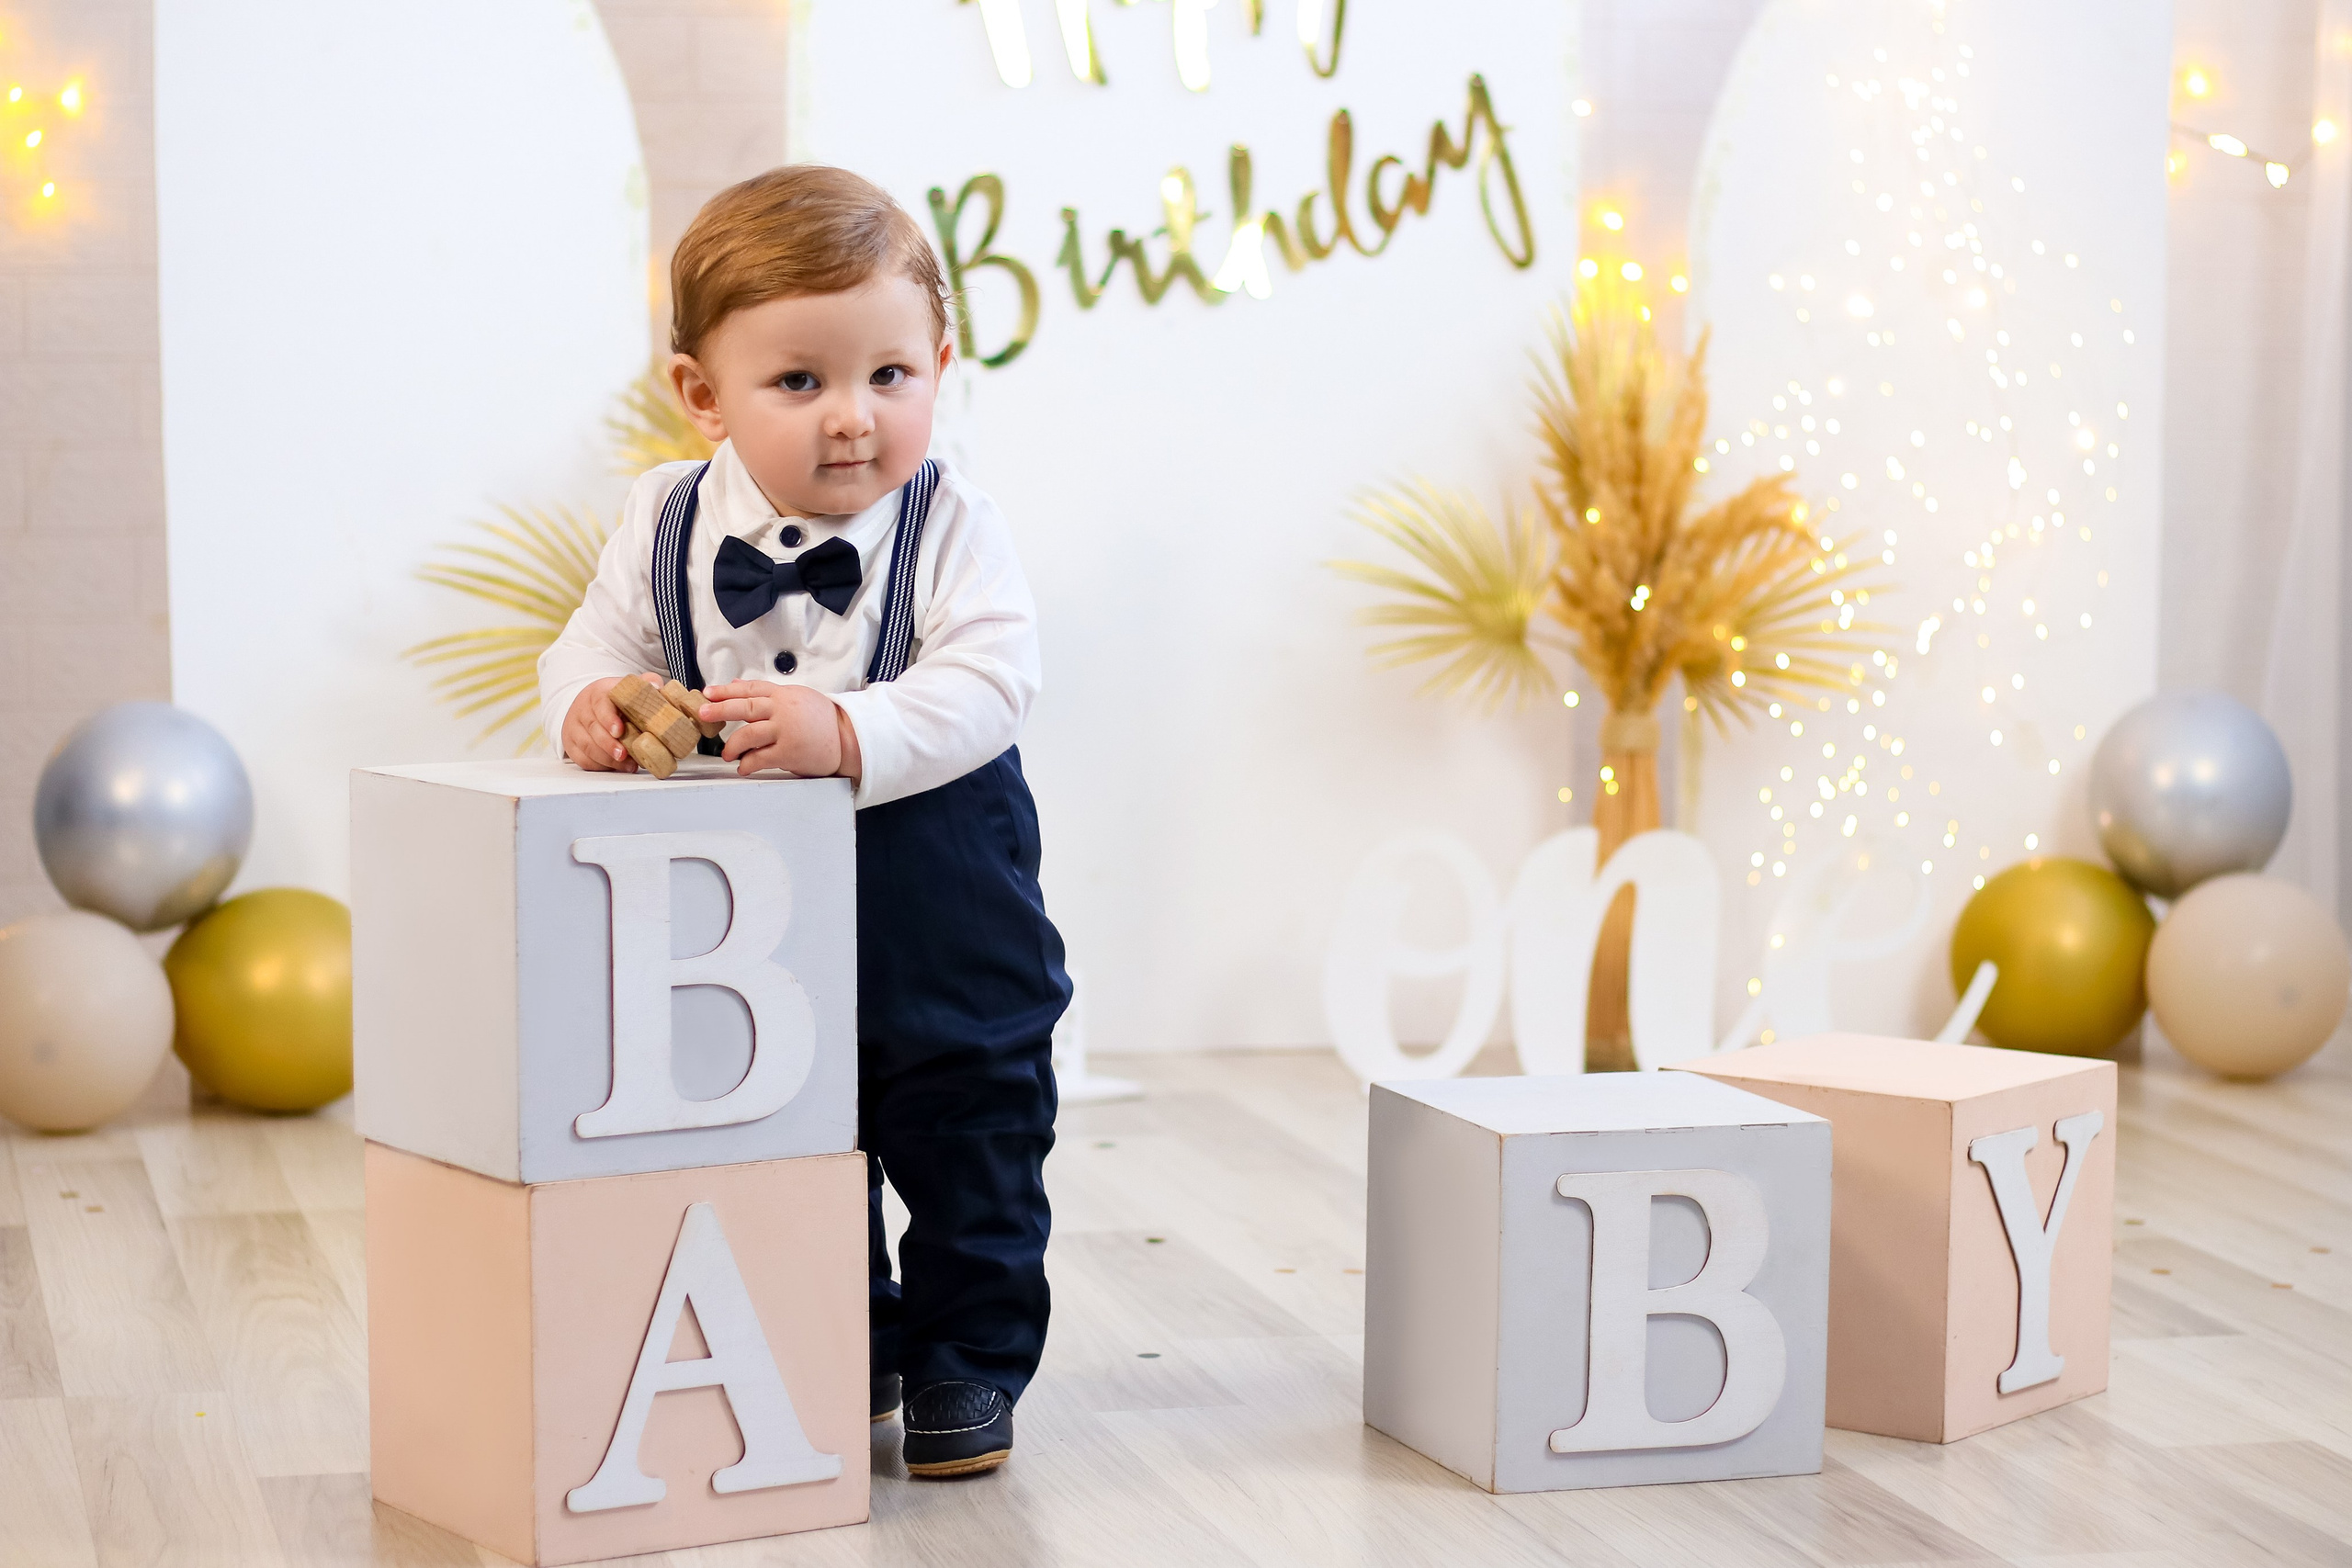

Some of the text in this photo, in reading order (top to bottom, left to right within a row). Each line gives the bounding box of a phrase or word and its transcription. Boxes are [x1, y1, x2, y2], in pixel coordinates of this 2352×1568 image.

[926, 73, 1535, 368] Birthday
[571, 830, 817, 1139] B
[566, 1201, 844, 1513] A
[1549, 1168, 1787, 1454] B
[1967, 1110, 2104, 1395] Y
